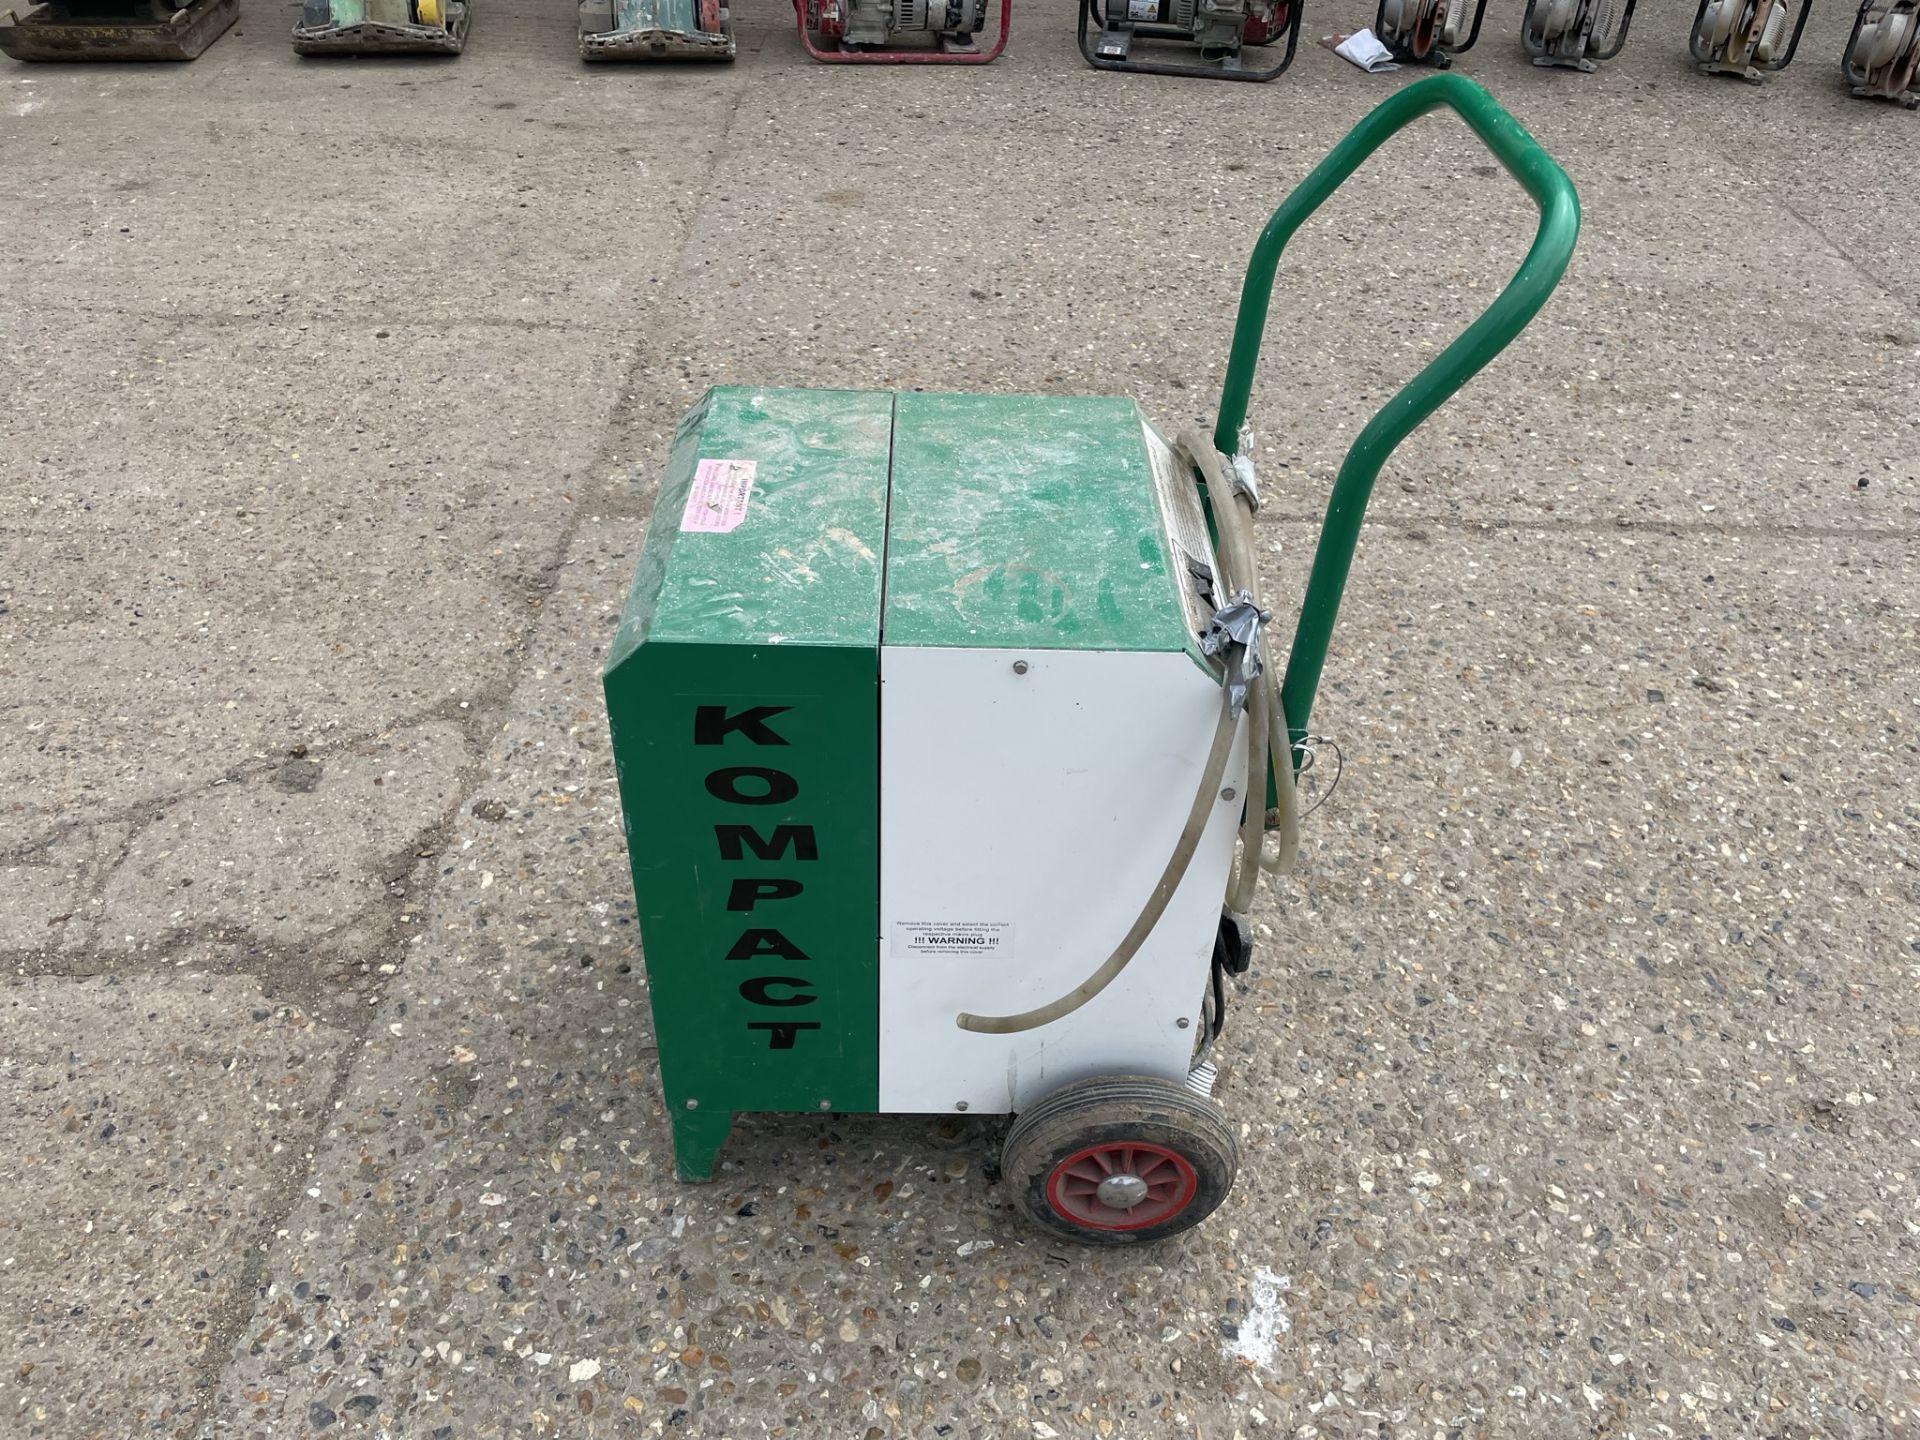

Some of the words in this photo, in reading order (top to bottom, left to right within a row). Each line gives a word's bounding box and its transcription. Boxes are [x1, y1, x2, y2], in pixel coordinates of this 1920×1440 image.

[694, 706, 821, 1049] KOMPACT
[914, 936, 925, 944] !!!
[928, 937, 985, 945] WARNING
